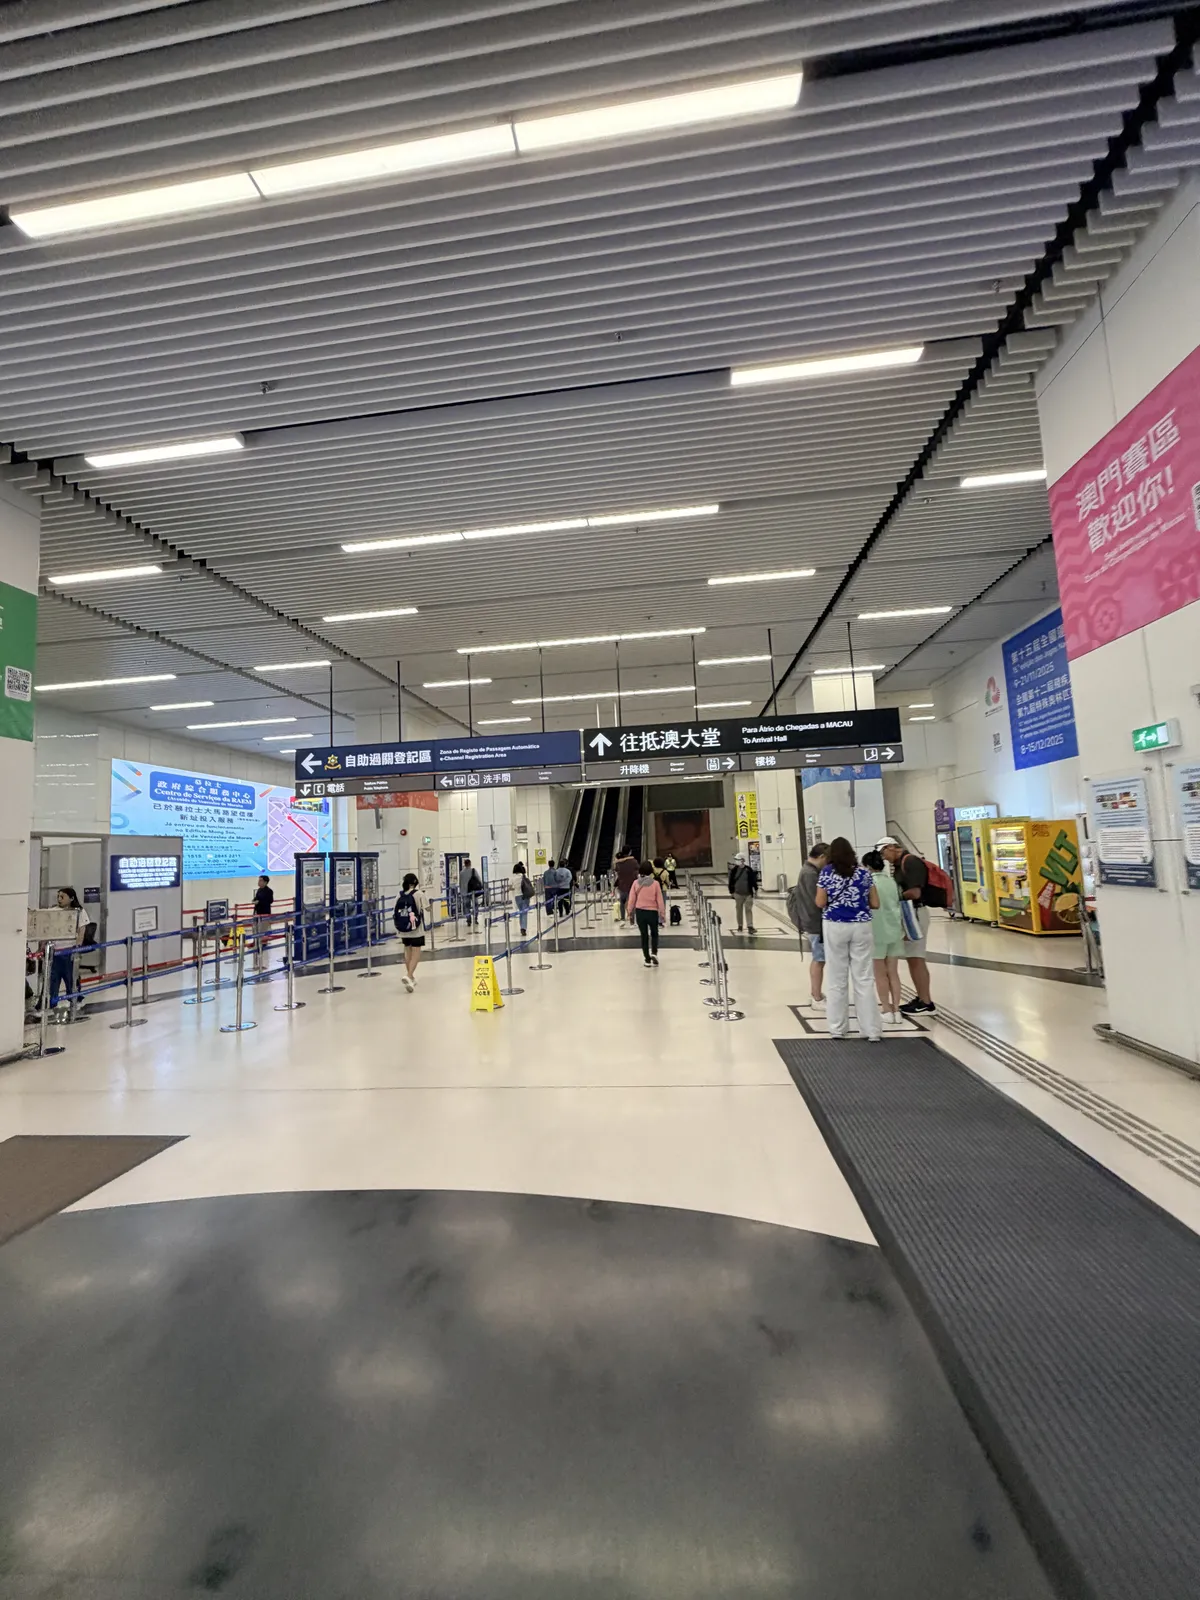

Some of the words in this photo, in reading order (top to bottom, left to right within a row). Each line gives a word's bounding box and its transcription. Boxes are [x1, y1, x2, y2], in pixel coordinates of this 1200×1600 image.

[1076, 408, 1180, 522] 澳門賽區
[785, 723, 819, 732] Chegadas
[825, 720, 853, 729] MACAU
[620, 728, 721, 753] 往抵澳大堂
[751, 736, 773, 744] Arrival
[1020, 733, 1064, 755] 8-15/12/2025
[345, 750, 431, 768] 自助過關登記區
[620, 764, 650, 775] 升降機
[483, 773, 511, 784] 洗手間
[327, 783, 345, 794] 電話
[231, 797, 252, 805] RAEM
